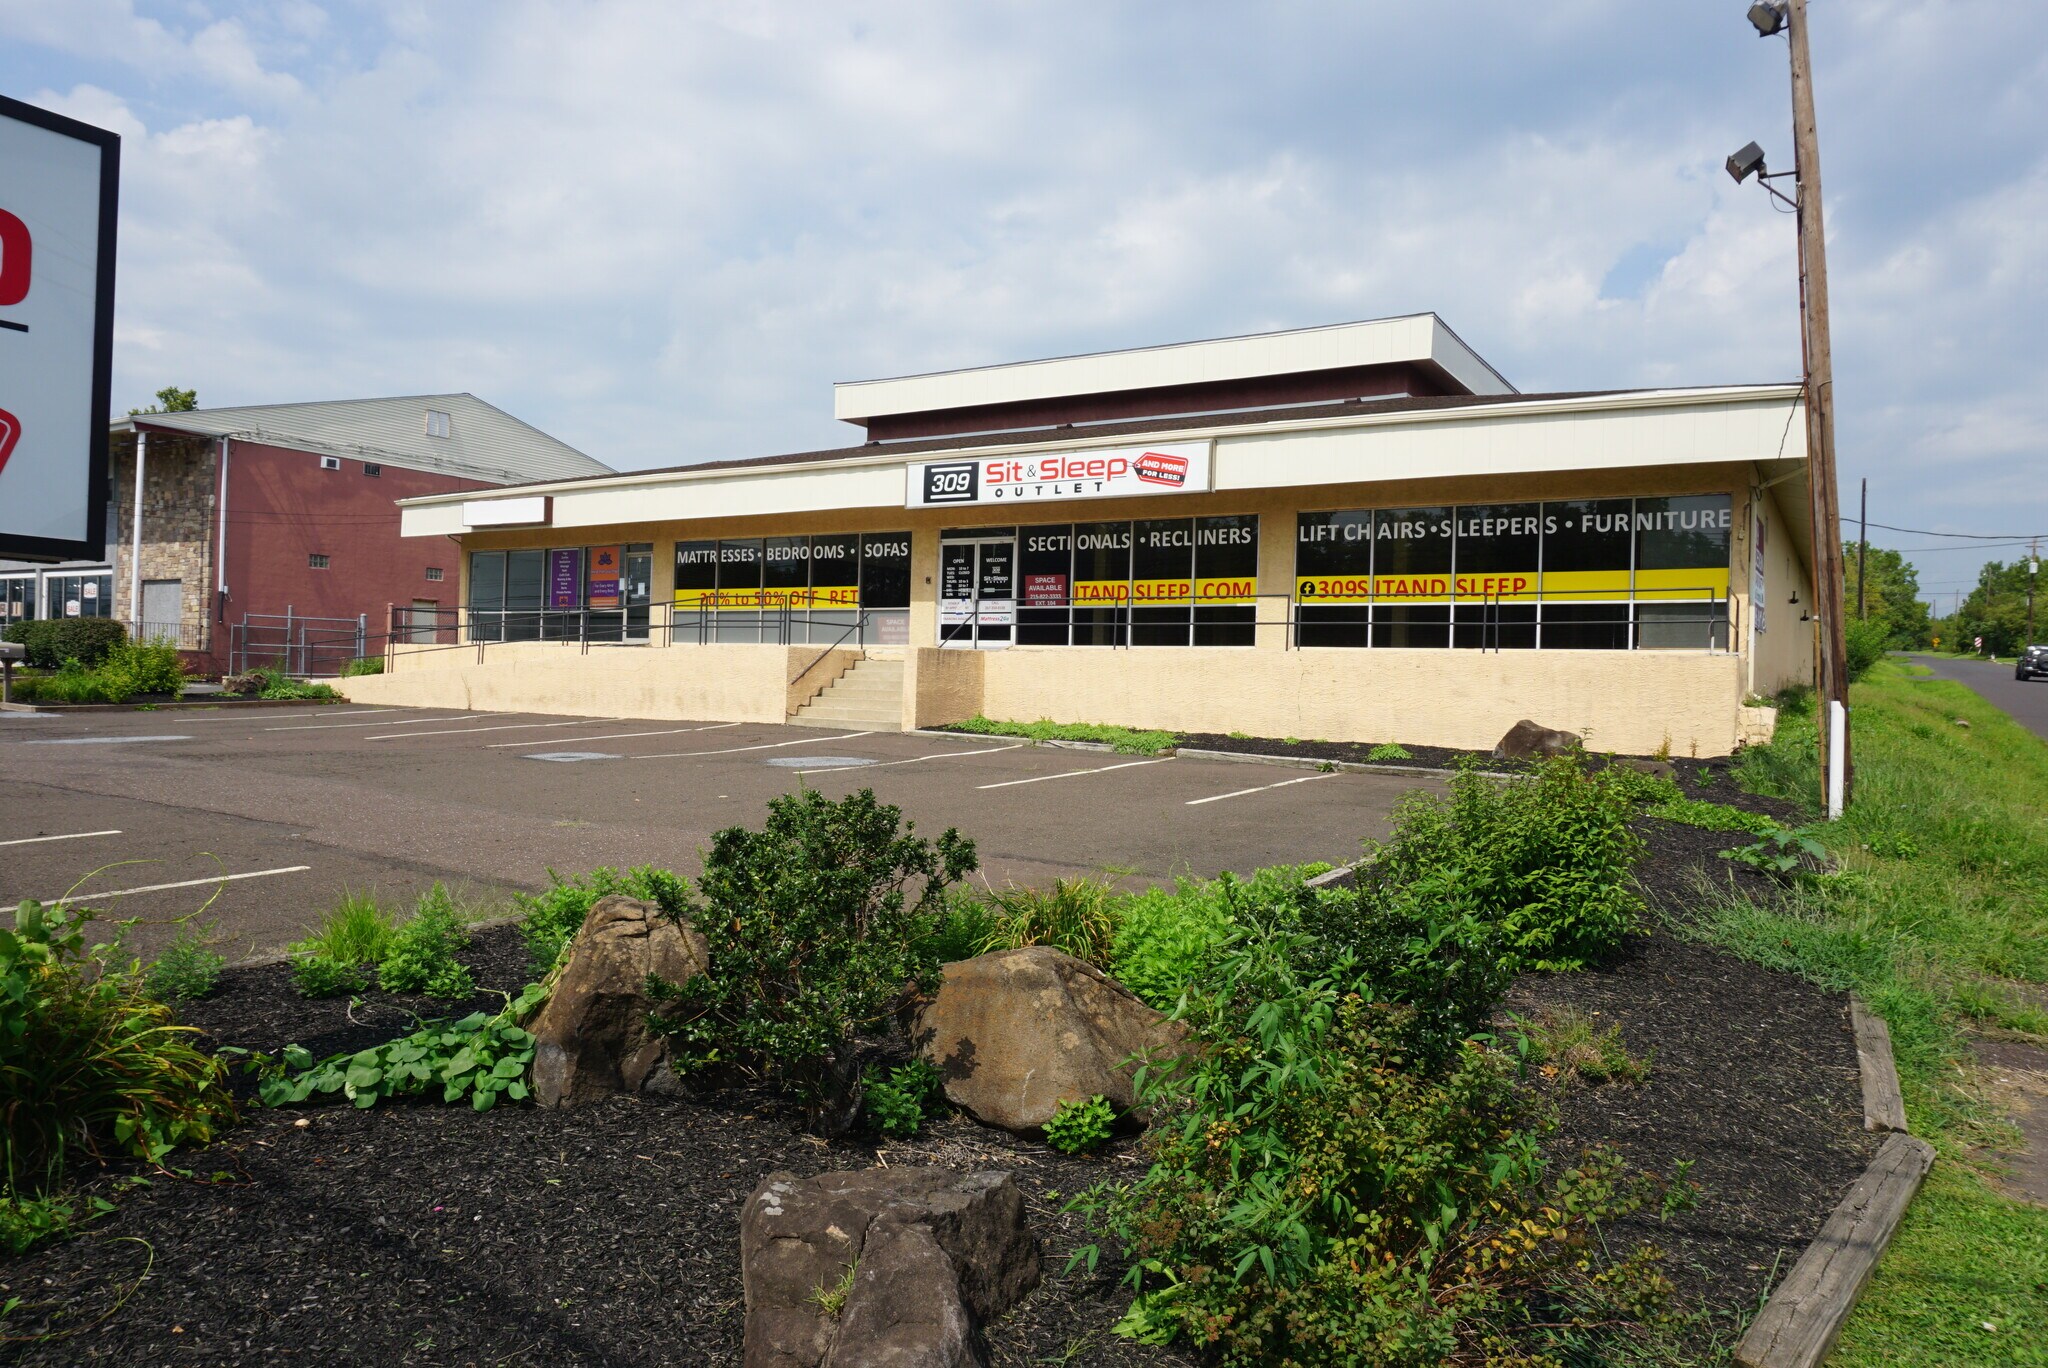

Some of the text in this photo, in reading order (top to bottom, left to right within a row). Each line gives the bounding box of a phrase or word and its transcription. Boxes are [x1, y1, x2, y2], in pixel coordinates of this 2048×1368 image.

[986, 457, 1128, 484] Sit & Sleep
[1142, 459, 1185, 473] AND MORE
[1142, 469, 1181, 481] FOR LESS!
[931, 473, 971, 493] 309
[994, 481, 1103, 498] OUTLET
[1300, 524, 1339, 542] LIFT
[1344, 520, 1426, 541] CHAIRS
[1582, 509, 1732, 533] FURNITURE
[1028, 527, 1252, 552] SECTIONALS RECLINERS
[676, 542, 909, 564] MATTRESSES BEDROOMS SOFAS
[754, 591, 785, 605] 50%
[790, 590, 819, 605] OFF
[829, 589, 859, 605] RET
